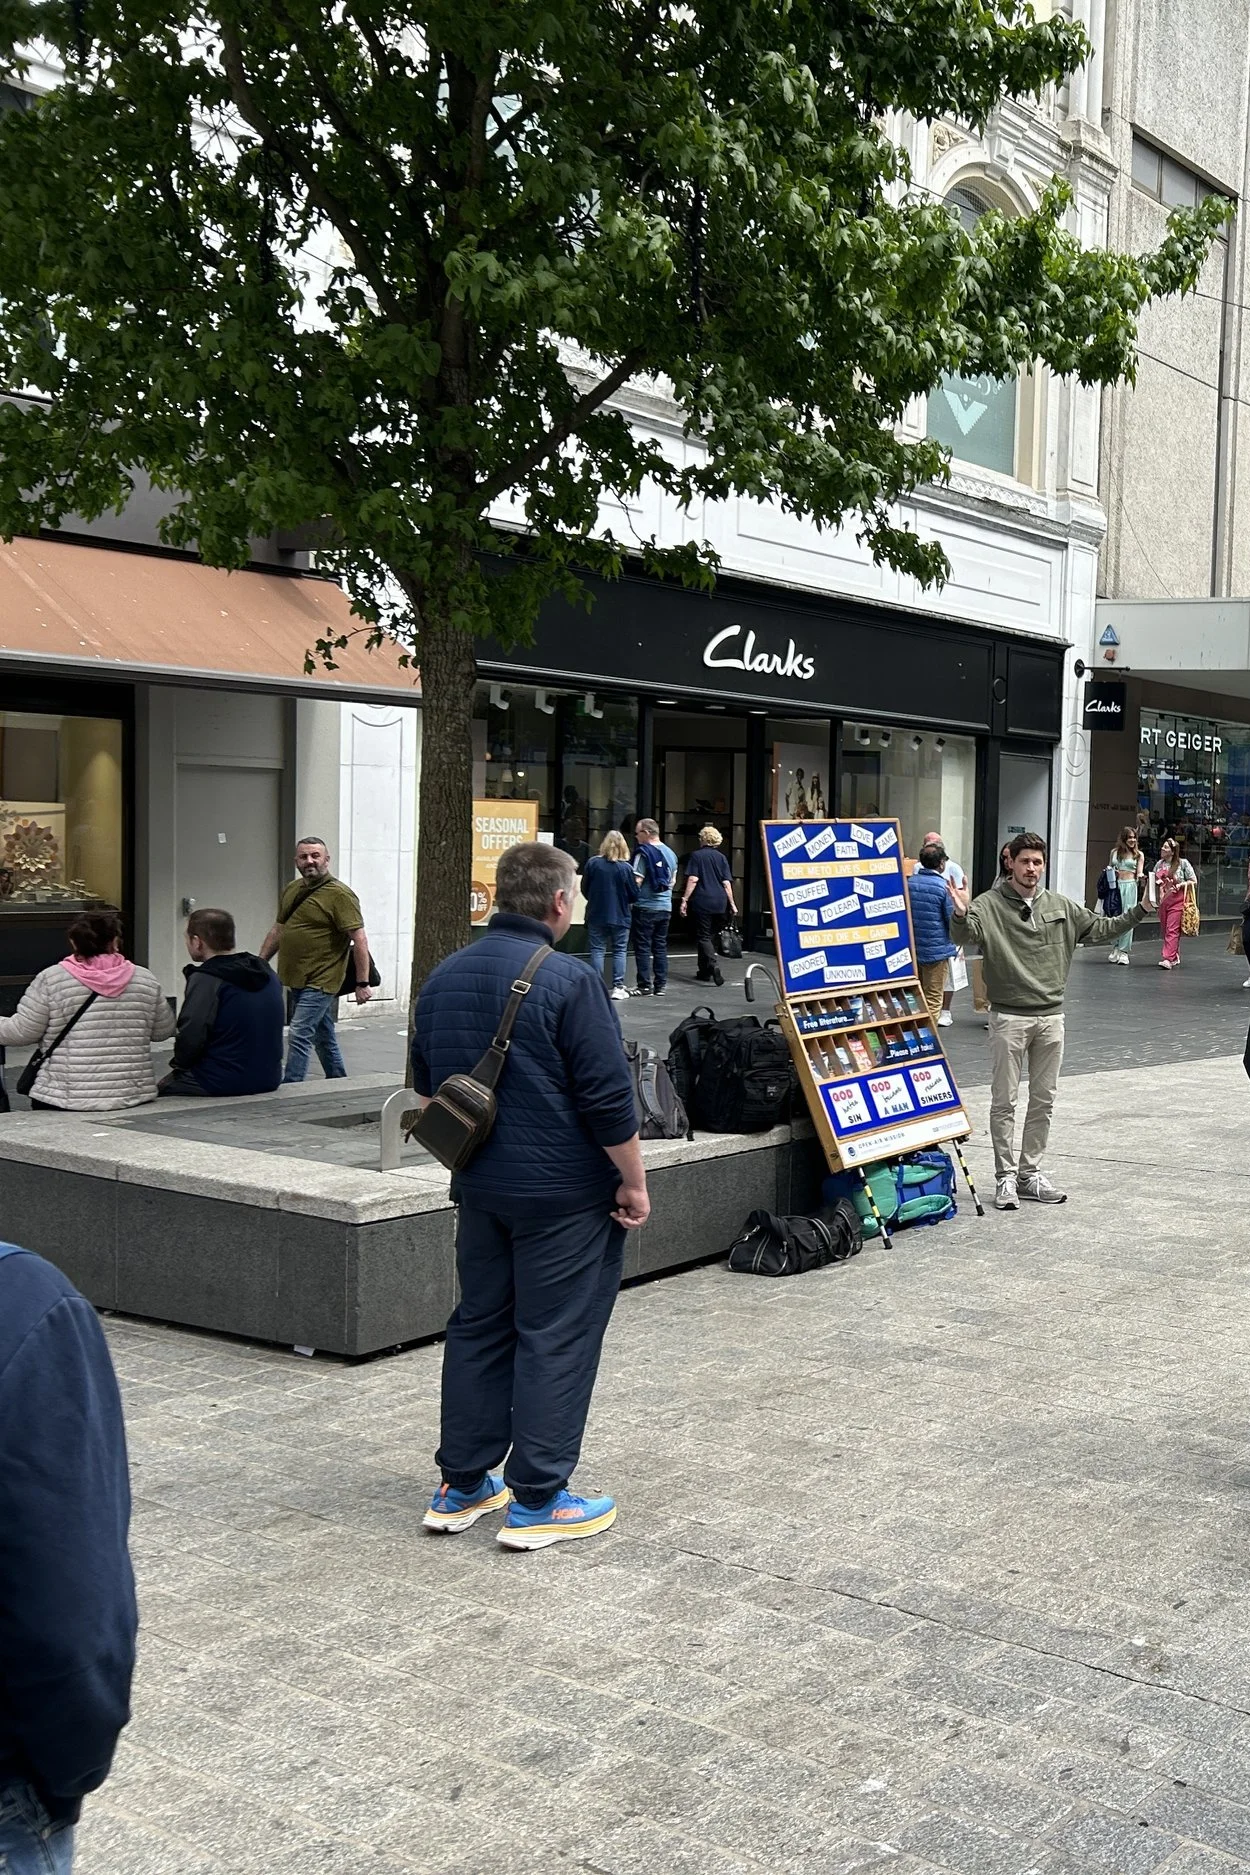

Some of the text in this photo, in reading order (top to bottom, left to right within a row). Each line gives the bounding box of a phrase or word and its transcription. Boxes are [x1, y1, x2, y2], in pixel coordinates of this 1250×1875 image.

[703, 624, 815, 680] Clarks
[1085, 699, 1122, 713] Clarks
[1140, 727, 1222, 753] RT GEIGER
[475, 817, 530, 833] SEASONAL
[481, 834, 524, 850] OFFERS
[776, 831, 804, 855] FAMILY
[852, 828, 871, 844] LOVE
[877, 833, 895, 849] FAME
[807, 832, 834, 855] MONEY
[836, 845, 857, 854] FAITH
[783, 884, 828, 903] TO SUFFER
[855, 881, 872, 894] PAIN
[470, 891, 487, 912] 0%
[822, 899, 859, 918] TO LEARN
[865, 898, 904, 914] MISERABLE
[798, 913, 815, 922] JOY
[865, 944, 883, 956] REST
[791, 955, 826, 974] IGNORED
[888, 952, 909, 967] PEACE
[825, 969, 865, 980] UNKNOWN
[803, 1019, 819, 1030] Free
[912, 1071, 932, 1082] GOD
[871, 1080, 892, 1093] GOD
[832, 1088, 854, 1102] GOD
[920, 1091, 953, 1105] SINNERS
[884, 1102, 910, 1115] A MAN
[847, 1113, 863, 1124] SIN
[552, 1507, 585, 1520] HOKA
